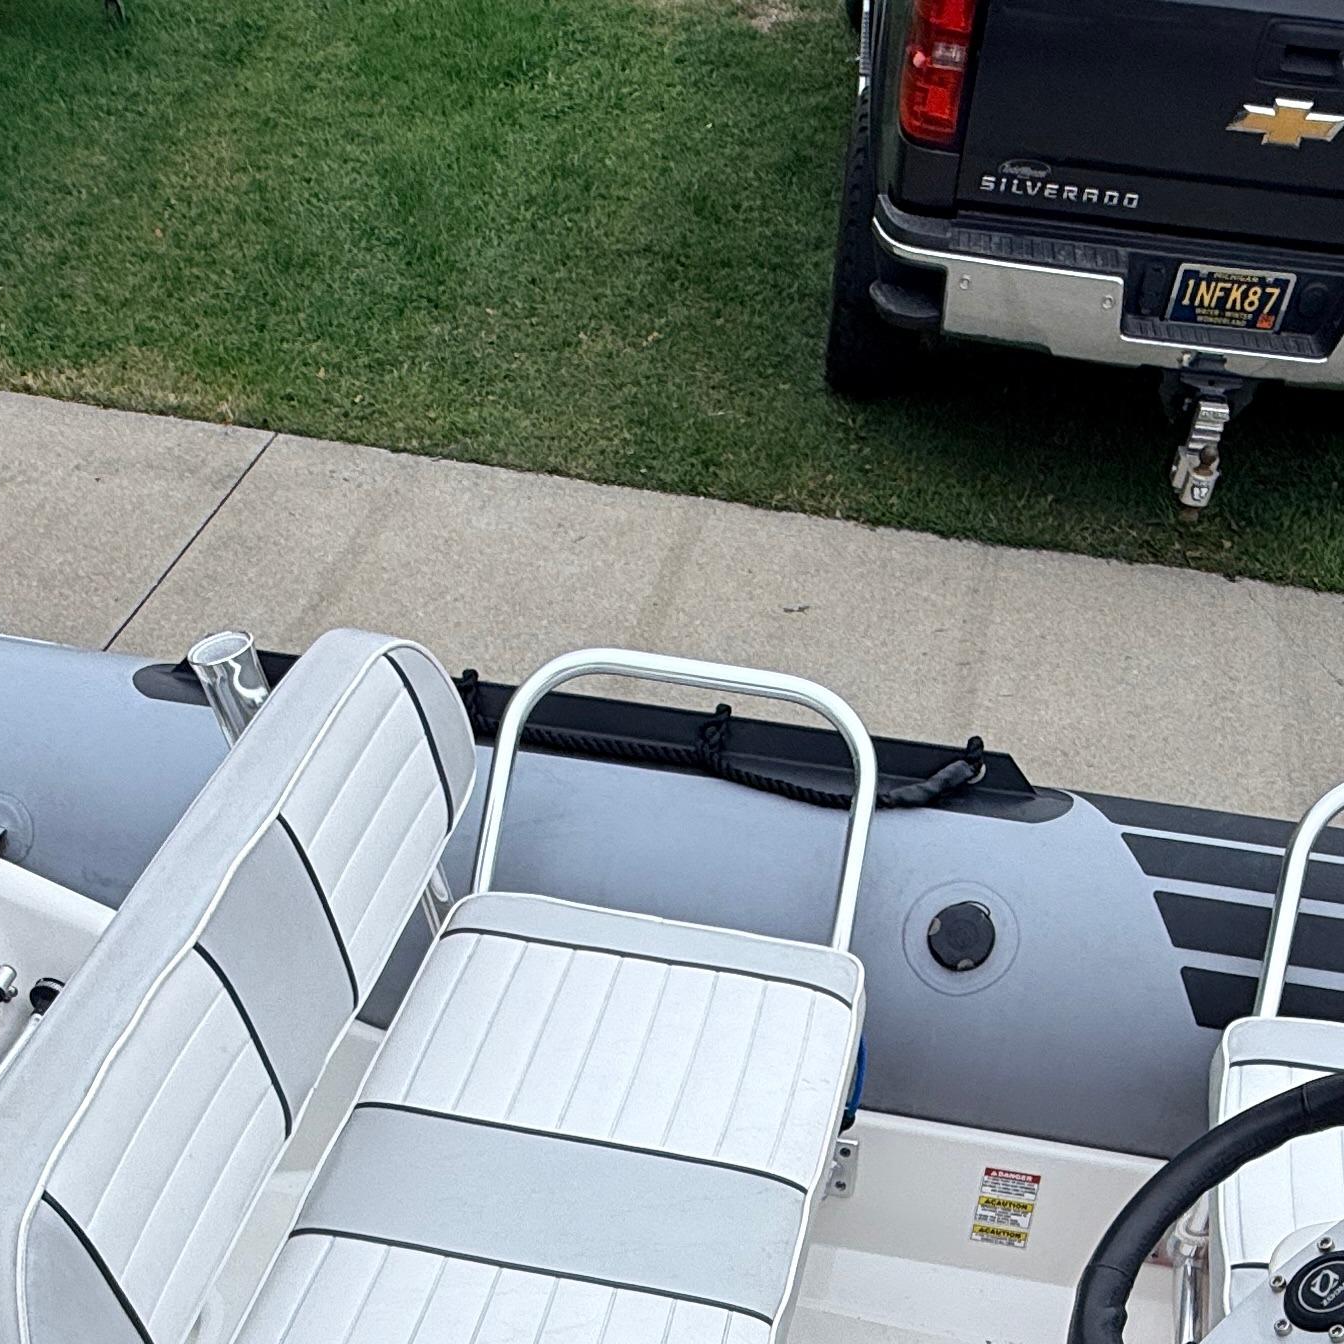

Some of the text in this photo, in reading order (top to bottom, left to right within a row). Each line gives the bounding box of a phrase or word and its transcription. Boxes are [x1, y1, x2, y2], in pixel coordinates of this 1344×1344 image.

[980, 176, 1140, 209] SILVERADO
[1181, 279, 1281, 315] 1NFK87
[998, 1171, 1033, 1182] DANGER
[990, 1198, 1028, 1210] CAUTION
[984, 1228, 1022, 1239] CAUTION
